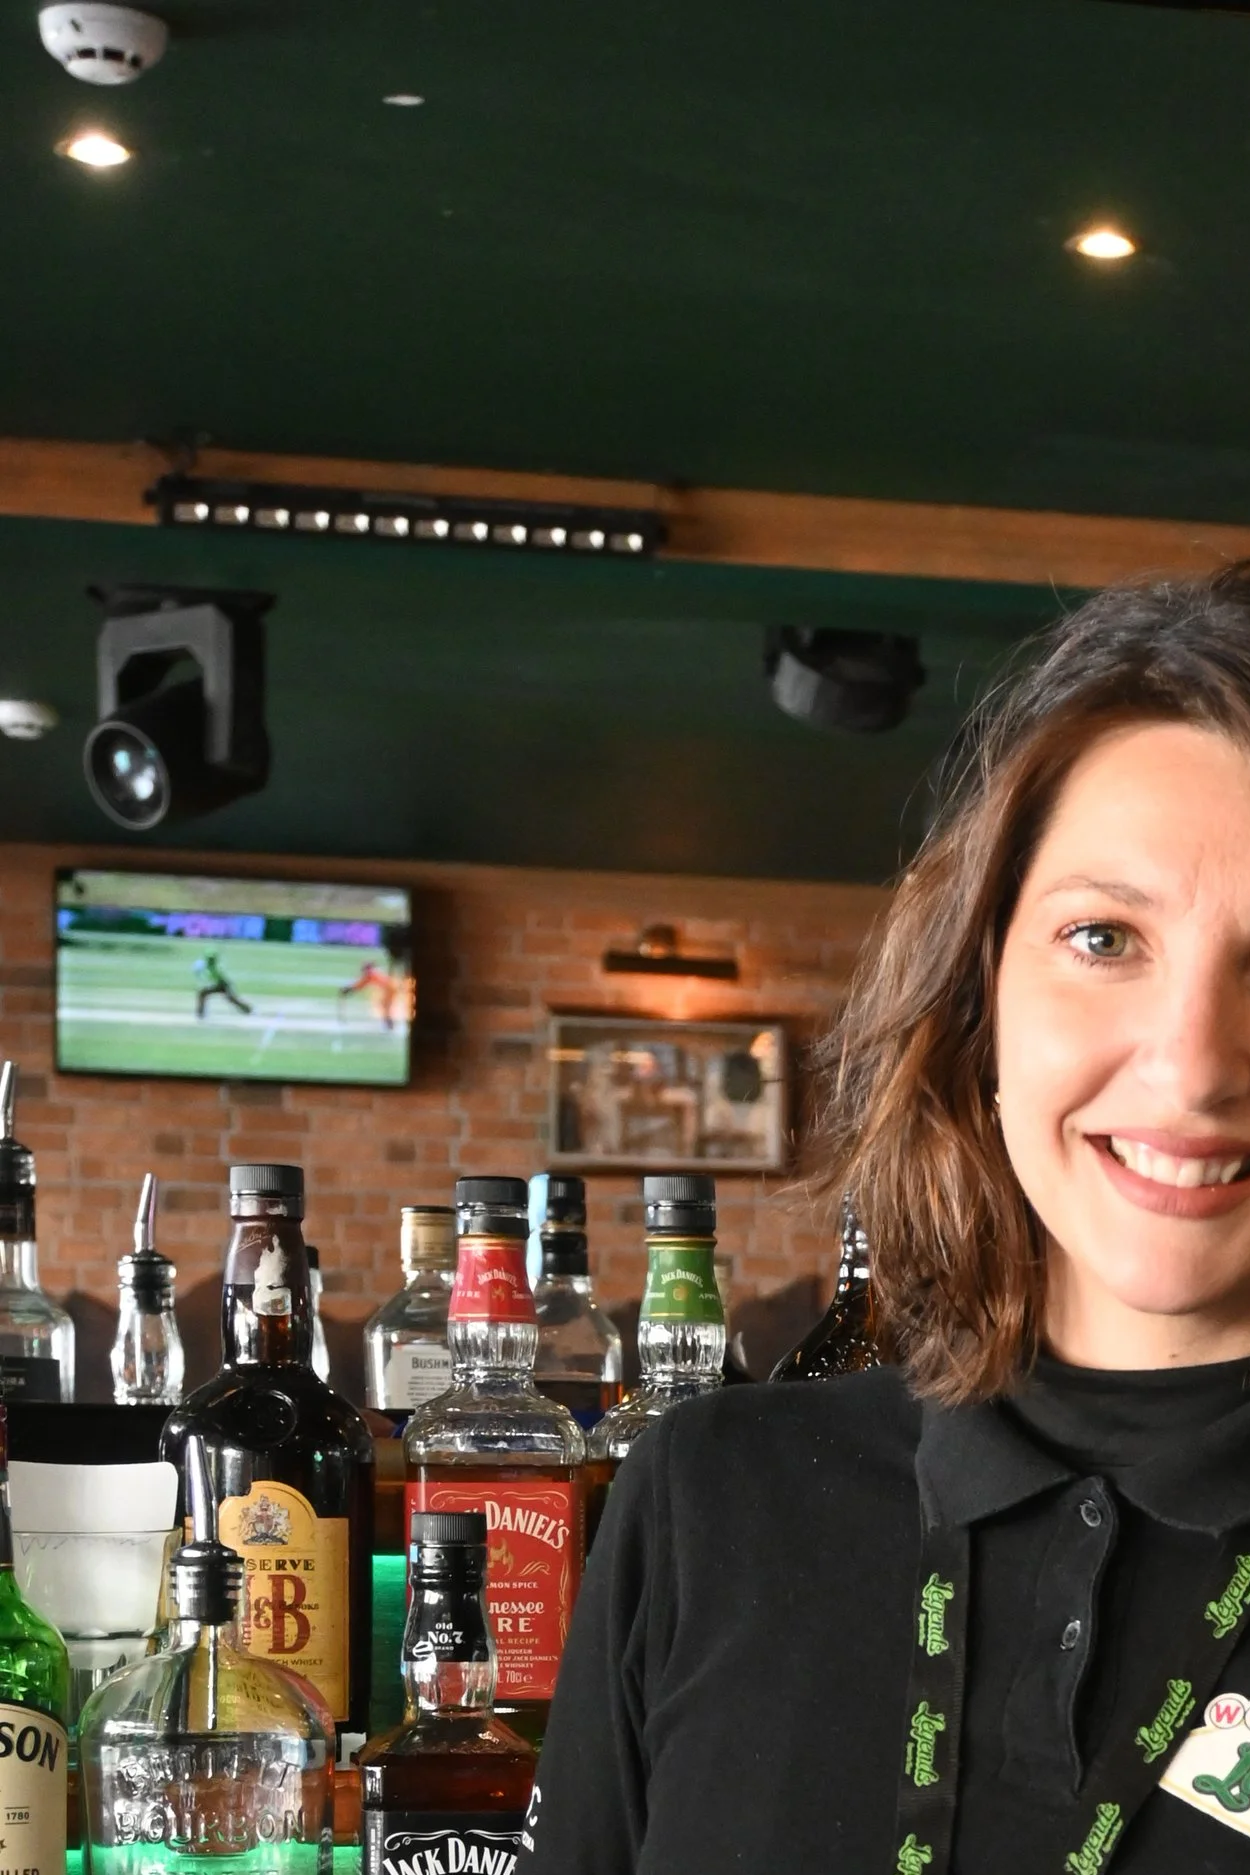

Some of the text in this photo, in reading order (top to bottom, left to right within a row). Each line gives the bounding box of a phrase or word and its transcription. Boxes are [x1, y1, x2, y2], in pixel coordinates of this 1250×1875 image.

[411, 1356, 449, 1369] BUSHM
[484, 1500, 570, 1551] DANIEL'S
[512, 1581, 538, 1589] SPICE
[488, 1600, 546, 1615] nessee
[922, 1572, 954, 1657] Legends
[497, 1617, 533, 1633] RE
[427, 1631, 463, 1645] No.7
[290, 1658, 323, 1667] WHISKY
[1135, 1679, 1192, 1764] Legends
[911, 1701, 946, 1786] Legends
[6, 1810, 30, 1821] 1780
